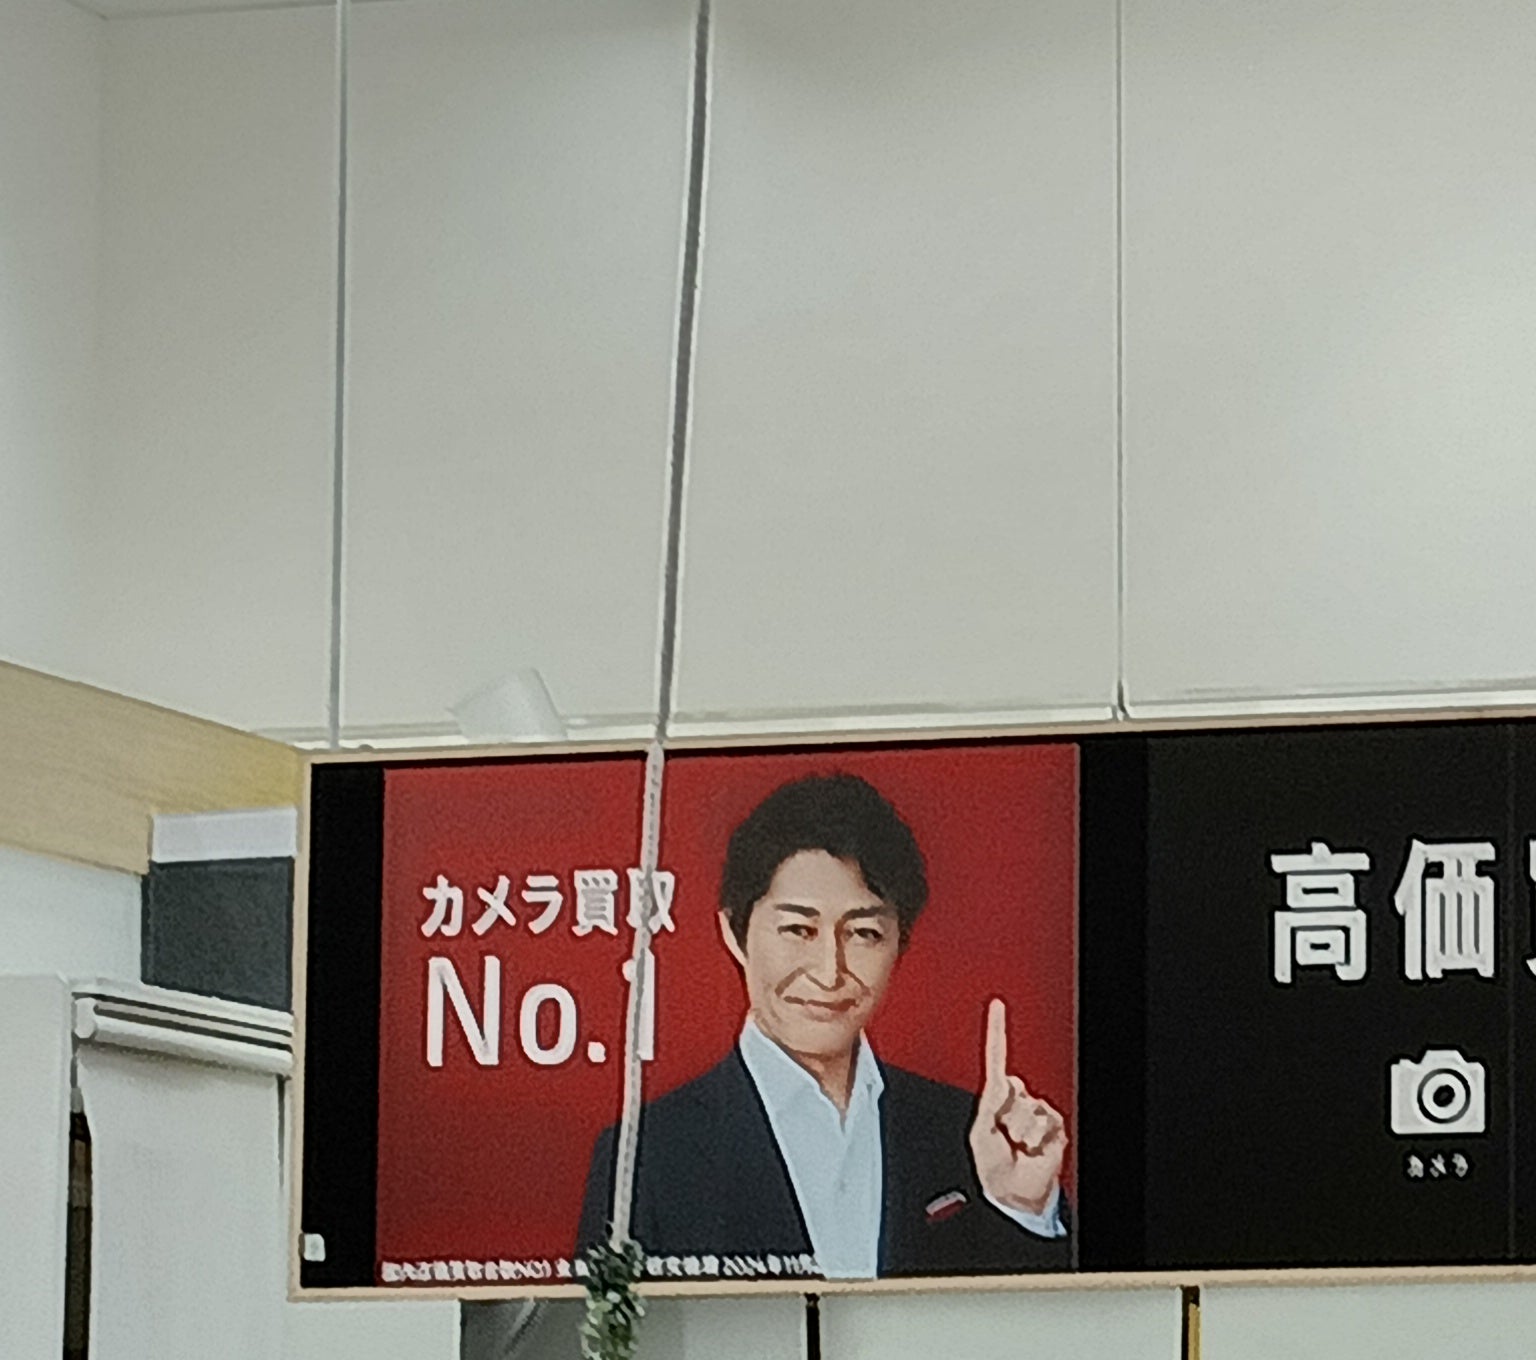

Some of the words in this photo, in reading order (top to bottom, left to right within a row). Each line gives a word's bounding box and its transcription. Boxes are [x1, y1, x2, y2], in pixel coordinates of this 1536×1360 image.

[420, 868, 677, 938] カメラ買取
[426, 948, 656, 1068] No.1
